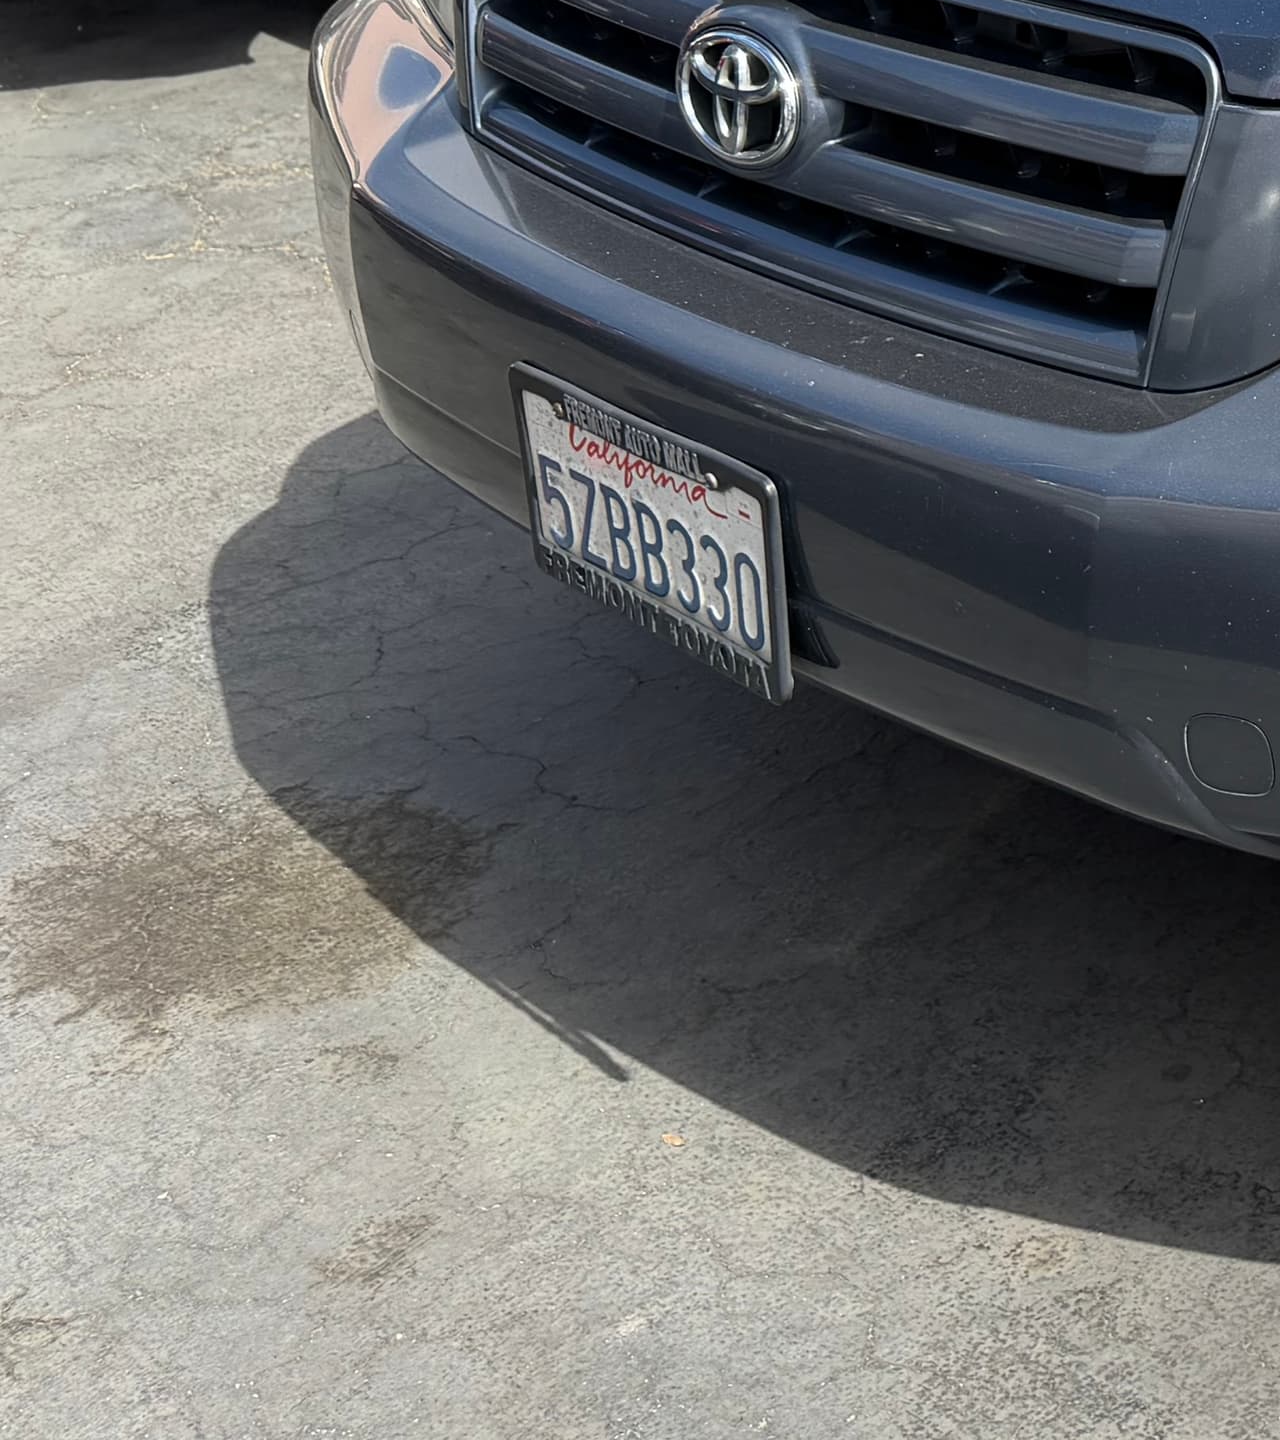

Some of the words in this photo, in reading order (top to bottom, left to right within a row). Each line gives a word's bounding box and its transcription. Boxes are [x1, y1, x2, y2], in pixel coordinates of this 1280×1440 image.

[563, 392, 622, 446] FREMONT
[624, 423, 662, 465] AUTO
[662, 440, 706, 483] MALL
[568, 422, 728, 519] California
[538, 451, 766, 652] 5ZBB330
[543, 545, 660, 633] FREMONT
[668, 615, 772, 701] TOYOTA
